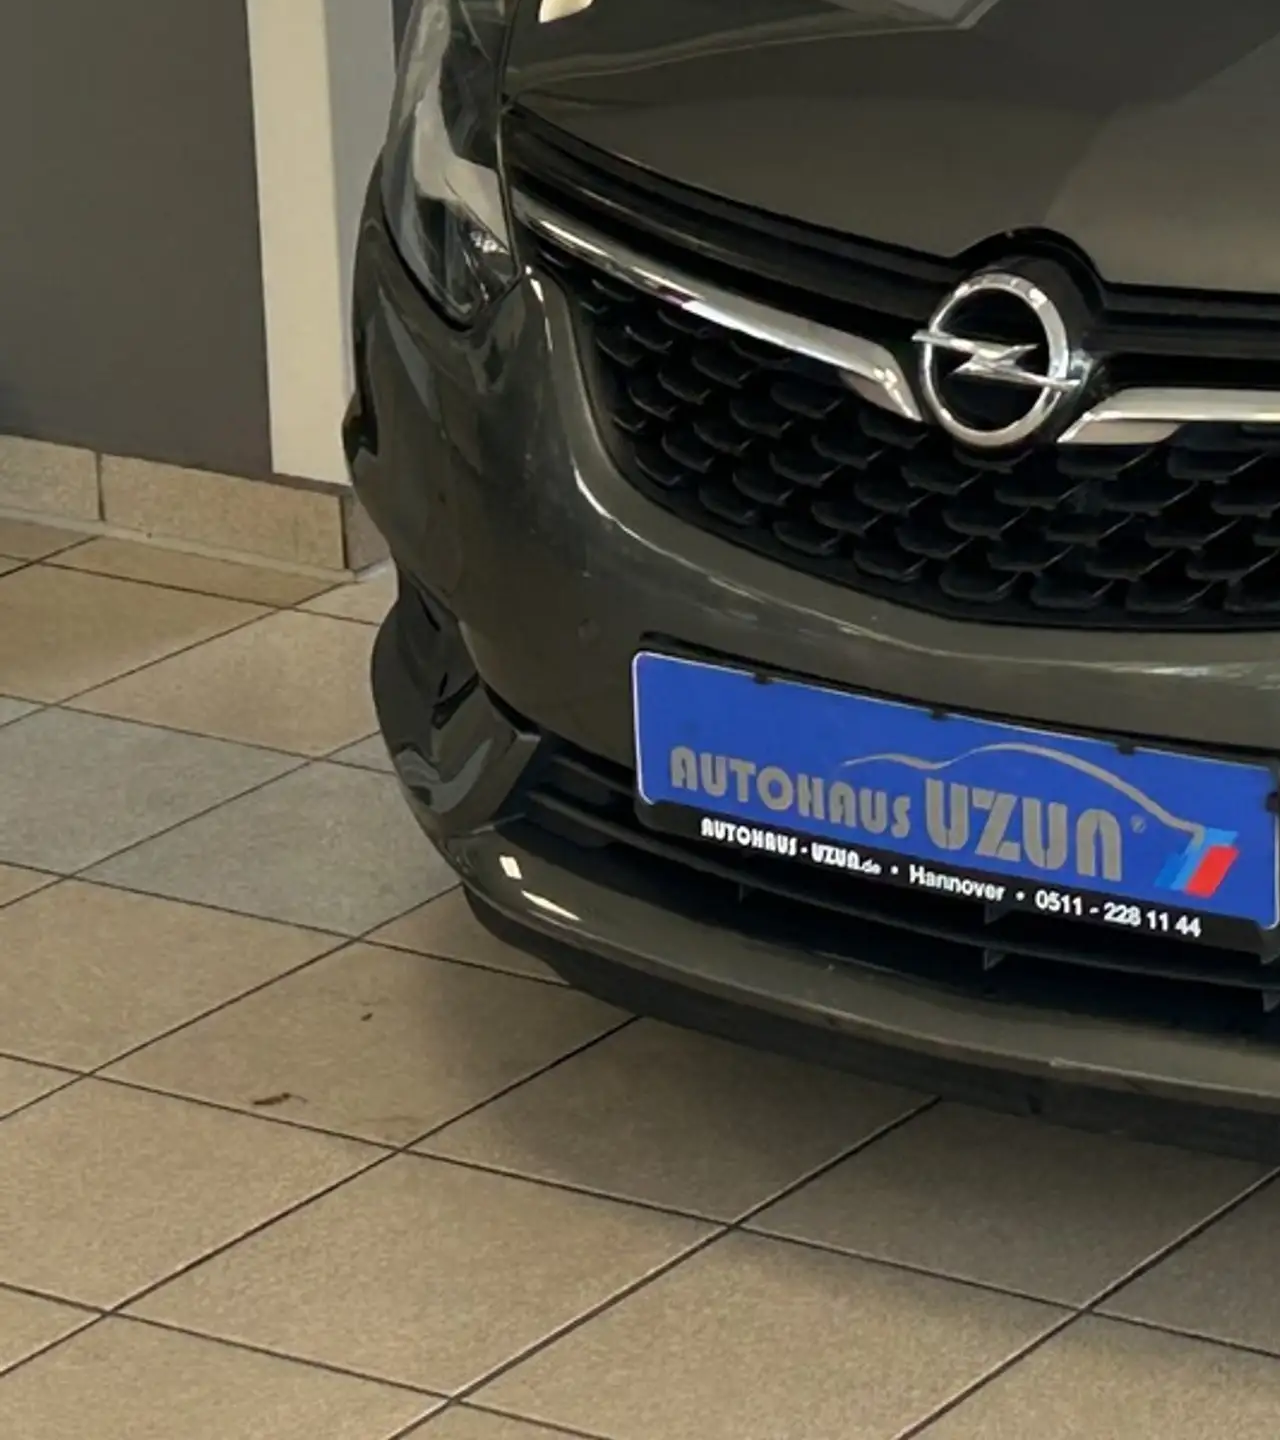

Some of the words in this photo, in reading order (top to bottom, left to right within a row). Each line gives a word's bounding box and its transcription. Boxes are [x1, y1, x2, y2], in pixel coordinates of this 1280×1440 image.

[670, 746, 911, 839] AUTOHAUS
[925, 777, 1122, 882] UZUN
[909, 864, 1005, 901] Hannover
[1035, 890, 1082, 916] 0511
[1103, 902, 1141, 926] 228
[1148, 911, 1168, 931] 11
[1175, 917, 1202, 937] 44
